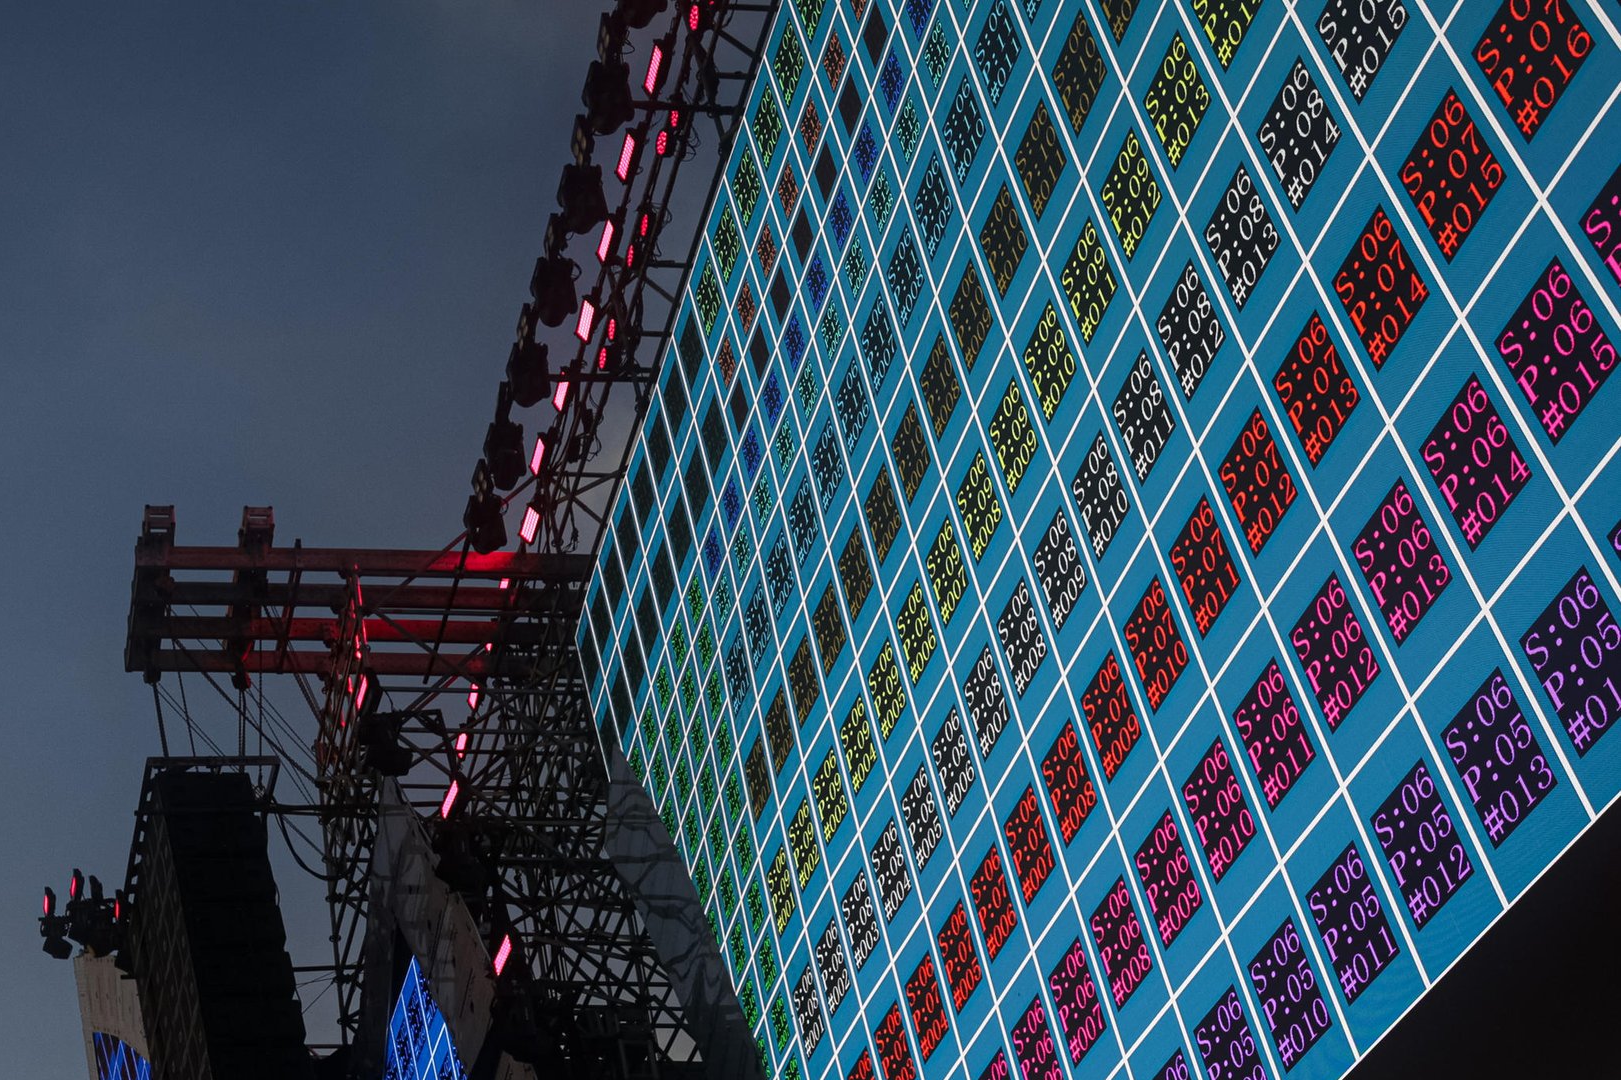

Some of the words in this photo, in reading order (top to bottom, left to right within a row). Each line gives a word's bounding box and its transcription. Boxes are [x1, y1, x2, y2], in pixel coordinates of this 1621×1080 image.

[774, 21, 793, 75] S:06
[785, 51, 804, 107] #005
[1054, 15, 1086, 90] S:06
[1062, 37, 1095, 111] P:10
[1146, 37, 1185, 118] S:06
[1350, 0, 1405, 97] #015
[1517, 25, 1590, 134] #016
[944, 79, 970, 144] S:06
[1072, 58, 1108, 131] #012
[1156, 61, 1196, 143] P:09
[1168, 85, 1208, 166] #013
[1260, 63, 1308, 154] S:06
[950, 101, 976, 164] P:11
[958, 118, 984, 182] #010
[1272, 89, 1323, 182] P:08
[1288, 117, 1340, 206] #014
[1403, 95, 1464, 196] S:06
[1207, 169, 1250, 253] S:06
[1418, 122, 1479, 228] P:07
[1439, 154, 1502, 255] #015
[981, 187, 1010, 253] S:06
[989, 209, 1017, 274] P:10
[1217, 195, 1264, 281] P:08
[998, 231, 1026, 295] #010
[1062, 223, 1096, 294] S:06
[1071, 247, 1105, 318] P:09
[1232, 223, 1277, 305] #013
[1336, 212, 1391, 304] S:06
[1350, 240, 1405, 336] P:07
[1082, 273, 1115, 341] #011
[1158, 266, 1198, 344] S:06
[1168, 292, 1210, 372] P:08
[1369, 274, 1427, 364] #014
[1501, 265, 1570, 368] S:06
[1182, 319, 1223, 396] #012
[1276, 317, 1326, 403] S:06
[1288, 345, 1338, 434] P:07
[1518, 300, 1592, 406] P:06
[1543, 333, 1615, 437] #015
[1221, 413, 1267, 493] S:06
[1306, 378, 1357, 462] #013
[1424, 382, 1487, 476] S:06
[958, 453, 984, 513] S:06
[1073, 436, 1107, 505] S:06
[1082, 462, 1117, 533] P:08
[1232, 441, 1278, 524] P:07
[1440, 416, 1507, 512] P:06
[1462, 451, 1529, 543] #014
[965, 477, 992, 537] P:09
[973, 500, 1001, 559] #008
[1093, 490, 1127, 557] #010
[1172, 501, 1213, 575] S:06
[1248, 474, 1295, 551] #012
[1356, 486, 1412, 572] S:06
[1182, 528, 1223, 605] P:07
[1196, 563, 1238, 633] #011
[1370, 519, 1430, 608] P:06
[1389, 555, 1448, 639] #013
[1293, 579, 1345, 660] S:06
[1306, 613, 1360, 695] P:06
[870, 643, 892, 694] S:06
[874, 665, 898, 717] P:09
[965, 648, 993, 707] S:06
[971, 673, 1001, 732] P:08
[1083, 656, 1119, 721] S:06
[1324, 648, 1377, 726] #012
[882, 687, 905, 739] #005
[980, 697, 1007, 757] #007
[1092, 682, 1127, 750] P:07
[1103, 714, 1139, 778] #009
[1446, 677, 1511, 764] S:06
[1185, 743, 1228, 813] S:06
[1462, 713, 1531, 804] P:05
[1195, 776, 1241, 847] P:06
[1375, 767, 1433, 848] S:06
[1484, 755, 1552, 841] #013
[872, 821, 897, 872] S:06
[878, 846, 904, 897] P:08
[972, 848, 1000, 904] S:06
[1210, 809, 1253, 877] #010
[1389, 803, 1451, 887] P:05
[885, 871, 911, 920] #004
[978, 874, 1006, 931] P:07
[1310, 849, 1363, 925] S:06
[1409, 845, 1470, 923] #012
[987, 903, 1016, 958] #006
[1251, 924, 1299, 994] S:06
[1323, 884, 1379, 962] P:05
[1051, 943, 1085, 1002] S:06
[1263, 958, 1314, 1031] P:05
[1340, 926, 1396, 998] #011
[876, 1005, 901, 1053] S:06
[1059, 973, 1094, 1032] P:06
[1070, 1003, 1102, 1062] #007
[1197, 992, 1242, 1058] S:06
[1279, 998, 1328, 1066] #010
[882, 1030, 907, 1079] P:07
